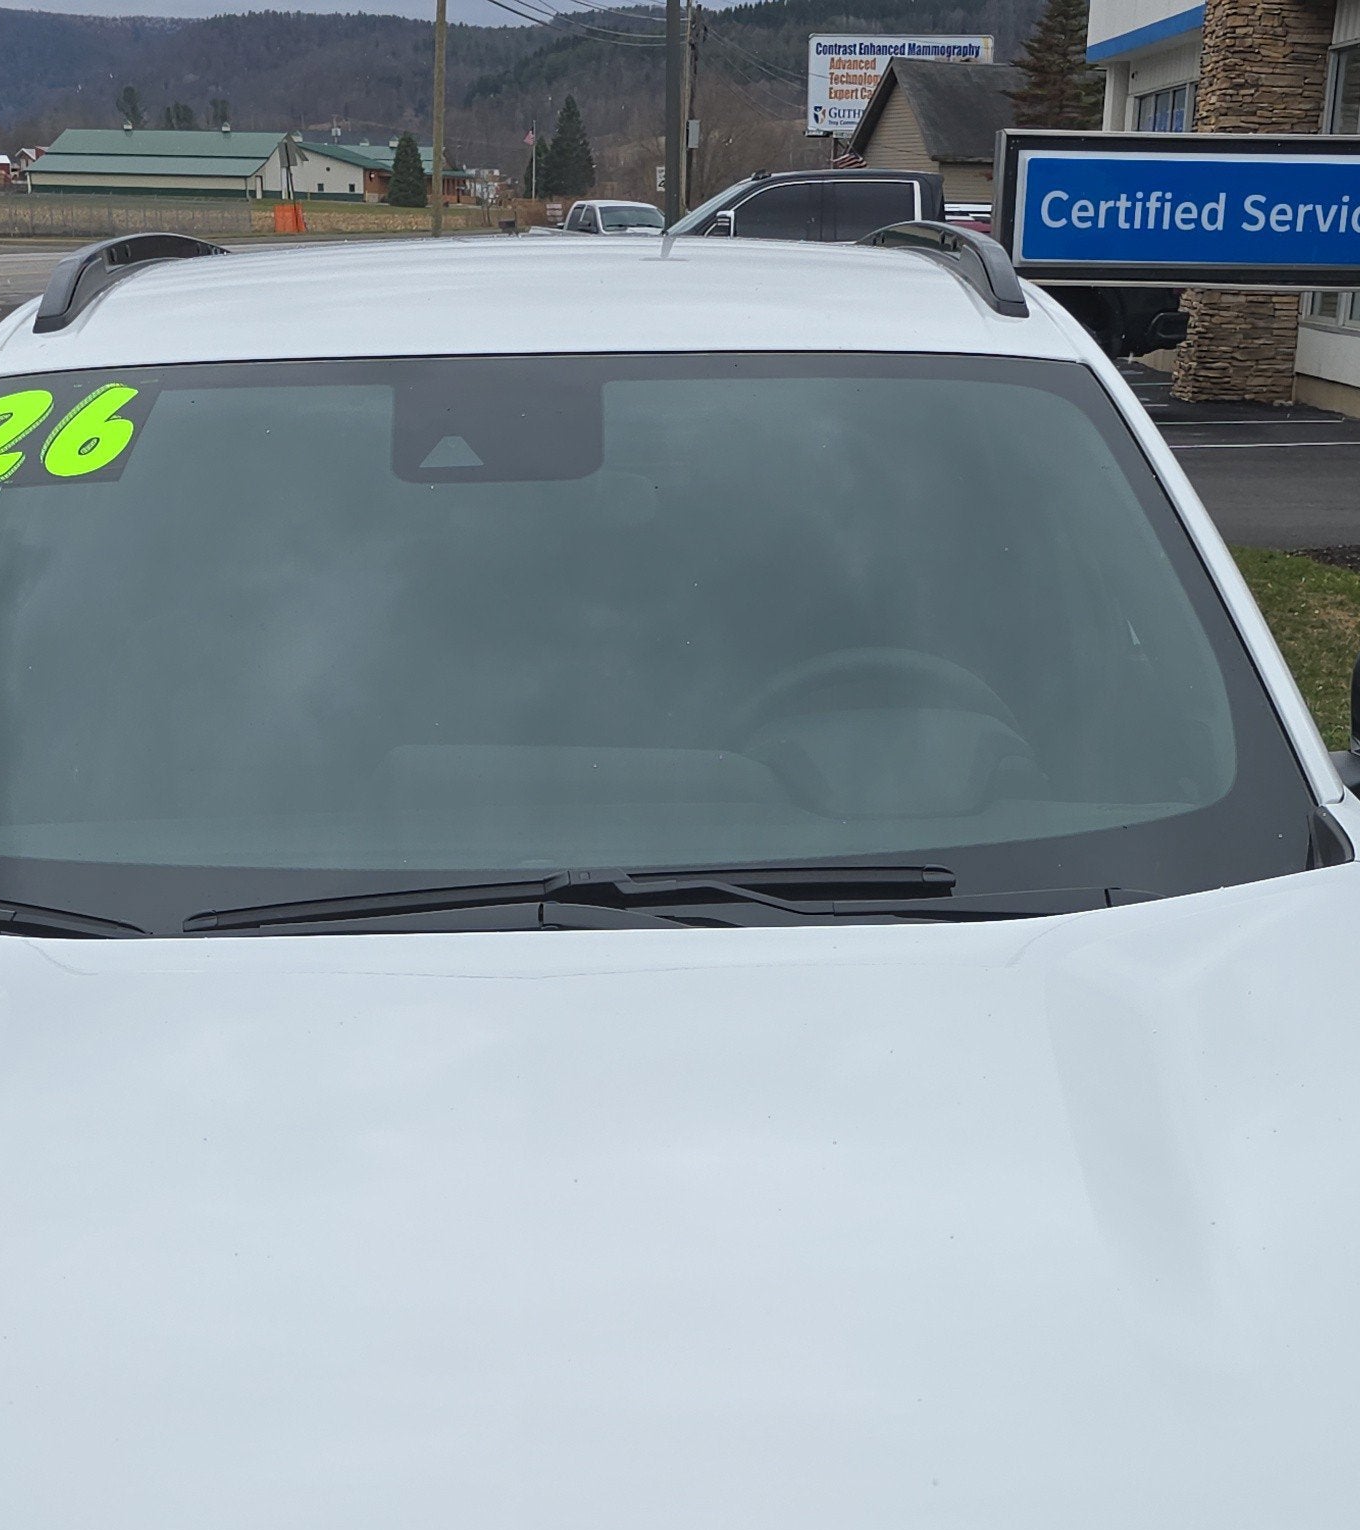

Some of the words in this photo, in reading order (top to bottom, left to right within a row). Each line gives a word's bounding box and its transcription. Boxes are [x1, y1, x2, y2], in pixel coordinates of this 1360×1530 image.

[815, 42, 857, 55] Contrast
[858, 42, 905, 56] Enhanced
[907, 43, 980, 58] Mammography
[829, 57, 876, 70] Advanced
[829, 72, 882, 86] Technolog
[829, 87, 858, 101] Expert
[860, 88, 873, 100] Ca
[1040, 190, 1226, 231] Certified
